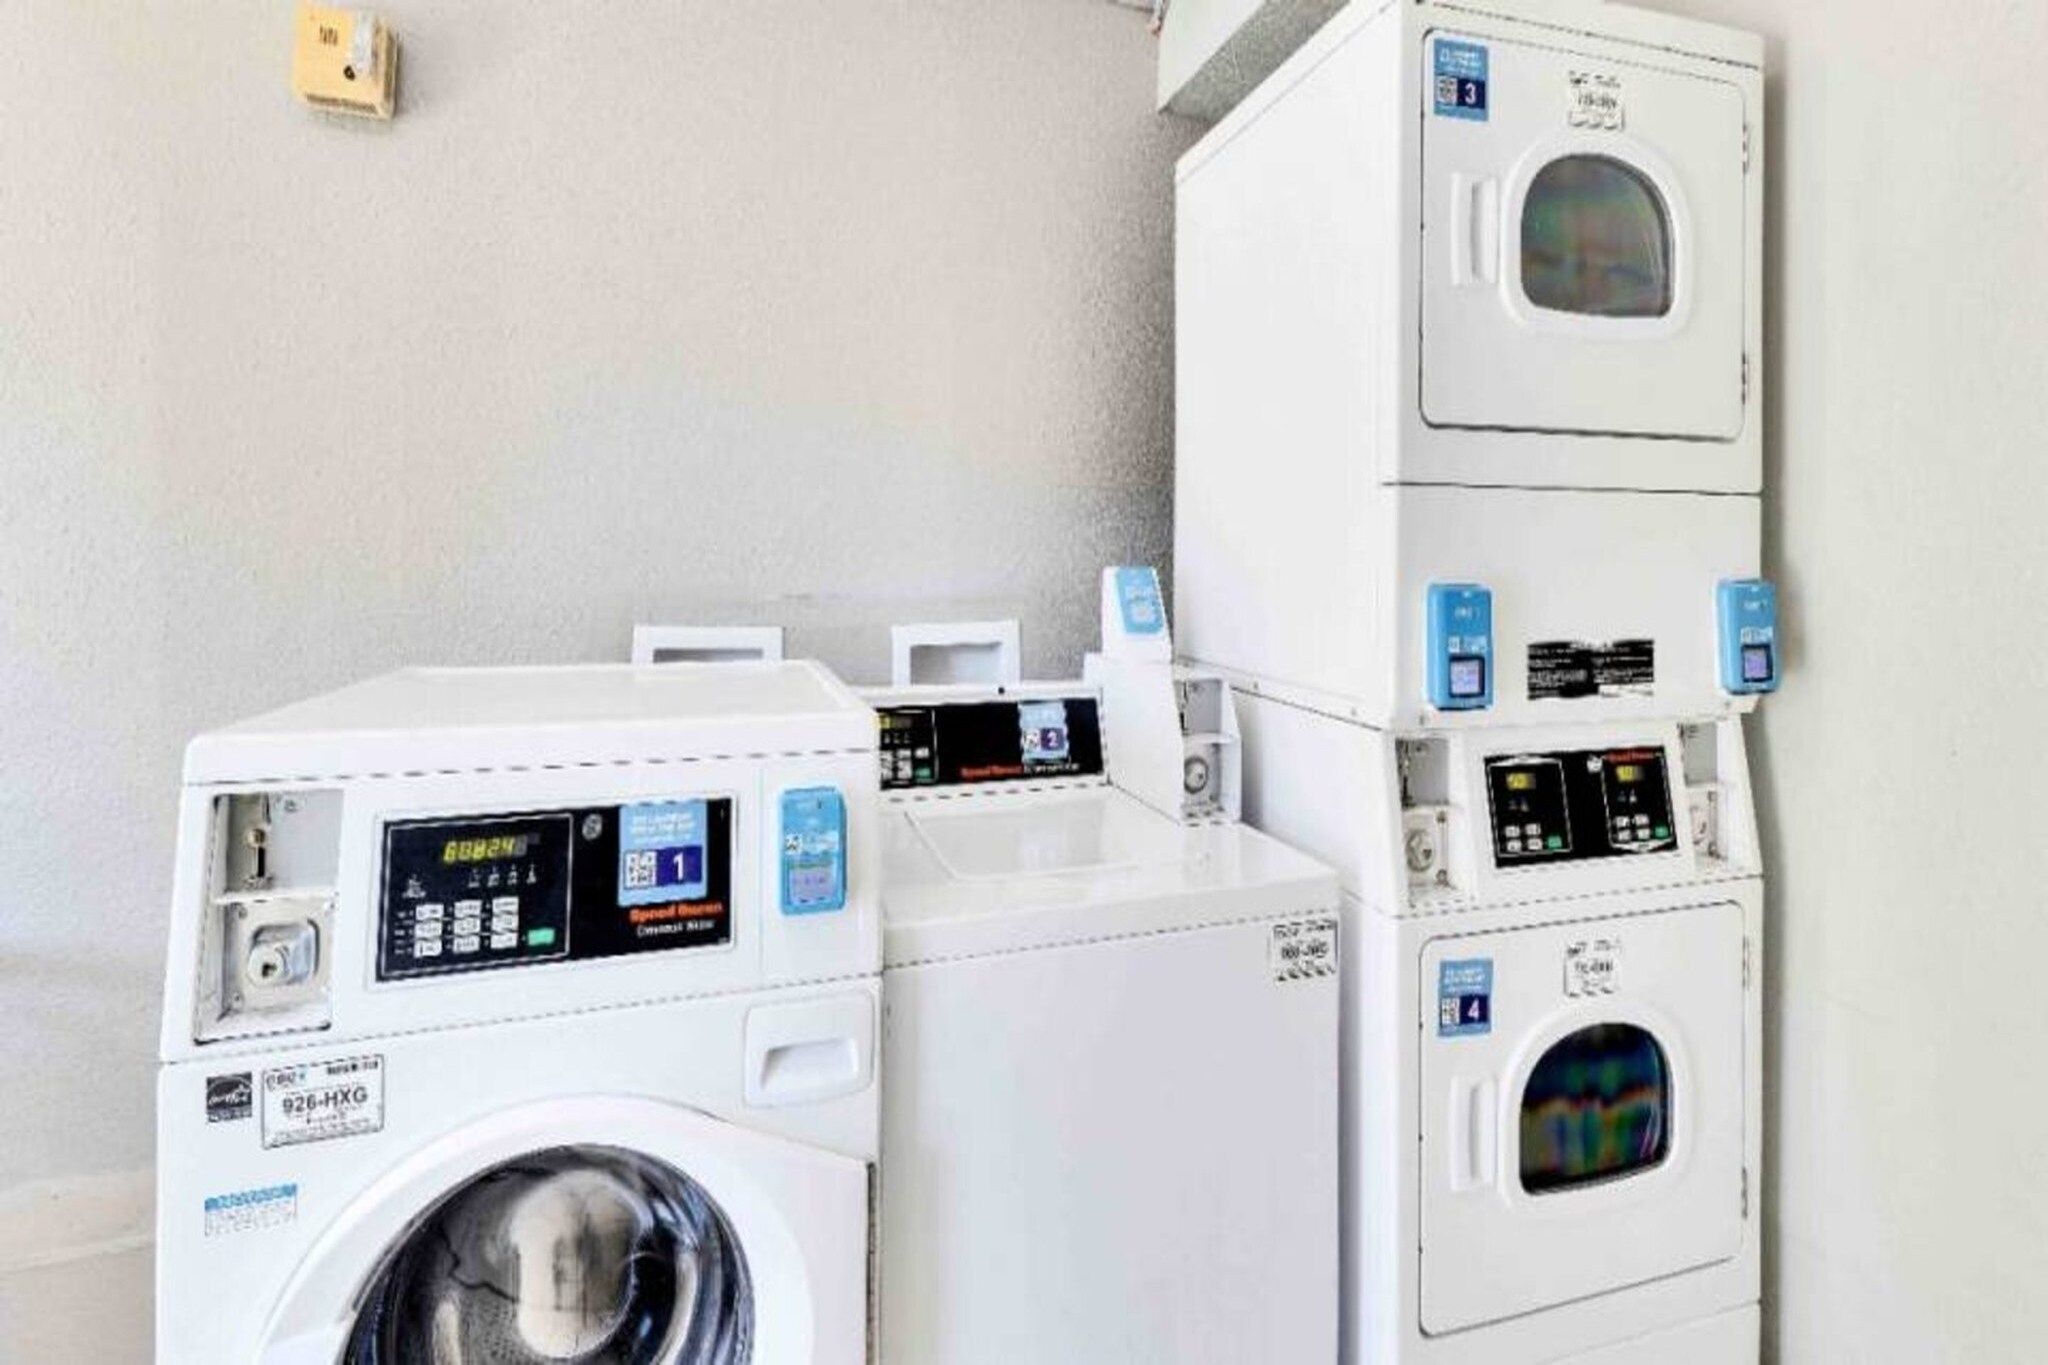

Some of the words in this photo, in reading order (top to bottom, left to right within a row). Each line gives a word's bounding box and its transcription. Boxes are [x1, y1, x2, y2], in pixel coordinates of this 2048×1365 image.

[1465, 83, 1476, 105] 3
[1047, 731, 1059, 748] 2
[673, 852, 684, 881] 1
[1467, 999, 1480, 1020] 4
[283, 1085, 368, 1114] 926-HXG
